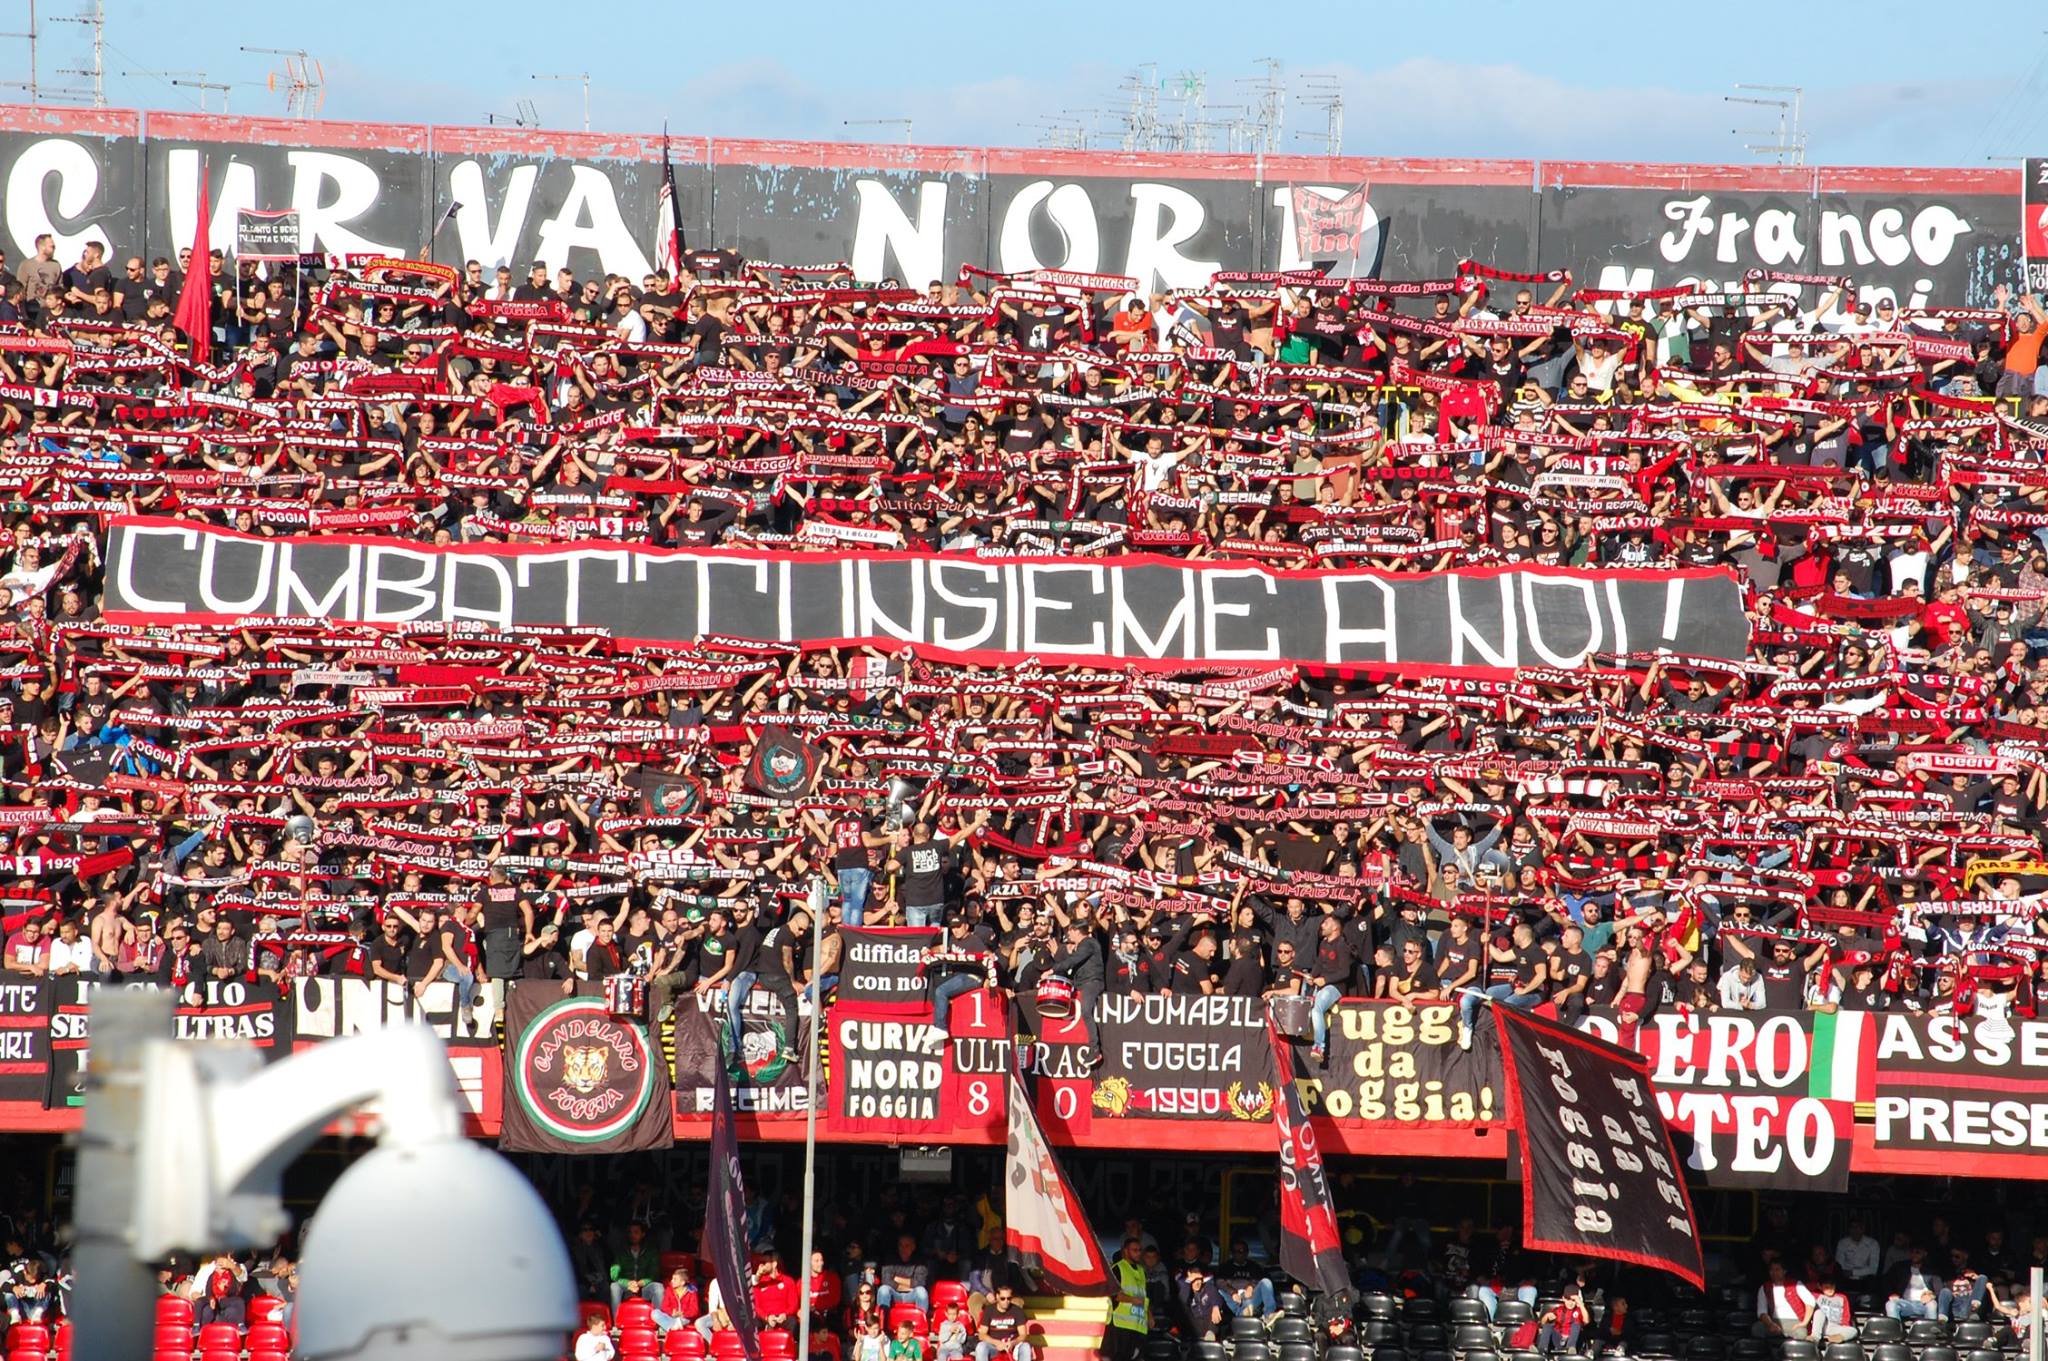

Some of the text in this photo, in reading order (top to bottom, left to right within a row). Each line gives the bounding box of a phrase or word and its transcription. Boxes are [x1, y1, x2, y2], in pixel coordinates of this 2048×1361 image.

[1660, 194, 1972, 267] Franco
[1936, 309, 2003, 319] NORD
[1503, 430, 1574, 446] NOCIVI
[610, 445, 671, 456] NORD
[1410, 442, 1481, 452] NOCIVI
[1368, 466, 1452, 479] FOGGIA
[440, 473, 507, 487] CURVA
[531, 495, 592, 505] NESSUNA
[692, 488, 728, 499] NORD
[1218, 491, 1272, 504] REGIME
[1150, 495, 1197, 509] FOGGIA
[1821, 497, 1855, 510] ANTI
[258, 510, 307, 523] FOGGIA
[1822, 526, 1915, 537] 1920
[842, 558, 1279, 661] INSIEME
[1322, 573, 1397, 663] A
[711, 636, 767, 649] NORD
[445, 651, 500, 660] NORD
[716, 662, 770, 673] NORD
[788, 676, 897, 689] ULTRAS 1980
[1064, 674, 1126, 682] NORD
[1826, 676, 1880, 690] NORD
[965, 684, 1023, 694] NORD
[1895, 708, 1981, 719] FOGGIA
[607, 718, 661, 728] NORD
[1649, 735, 1703, 751] NORD
[1442, 764, 1481, 778] ANTI
[1764, 778, 1825, 788] NORD
[1454, 802, 1491, 812] NORD
[646, 818, 683, 826] NORD
[911, 849, 938, 862] UNICA
[566, 862, 626, 876] REGIME
[566, 883, 628, 897] REGIME
[289, 933, 343, 942] NORD
[852, 975, 892, 991] con
[840, 1020, 945, 1055] CURVA
[535, 1019, 639, 1072] CANDELARO
[1122, 1042, 1242, 1072] FOGGIA
[1353, 1042, 1417, 1079] da
[851, 1060, 943, 1089] NORD
[549, 1087, 624, 1120] FOGGIA
[968, 1081, 990, 1116] 8
[1144, 1087, 1220, 1114] 1990
[1295, 1078, 1494, 1122] Foggia!
[849, 1095, 937, 1119] FOGGIA
[1536, 1041, 1620, 1234] Foggia
